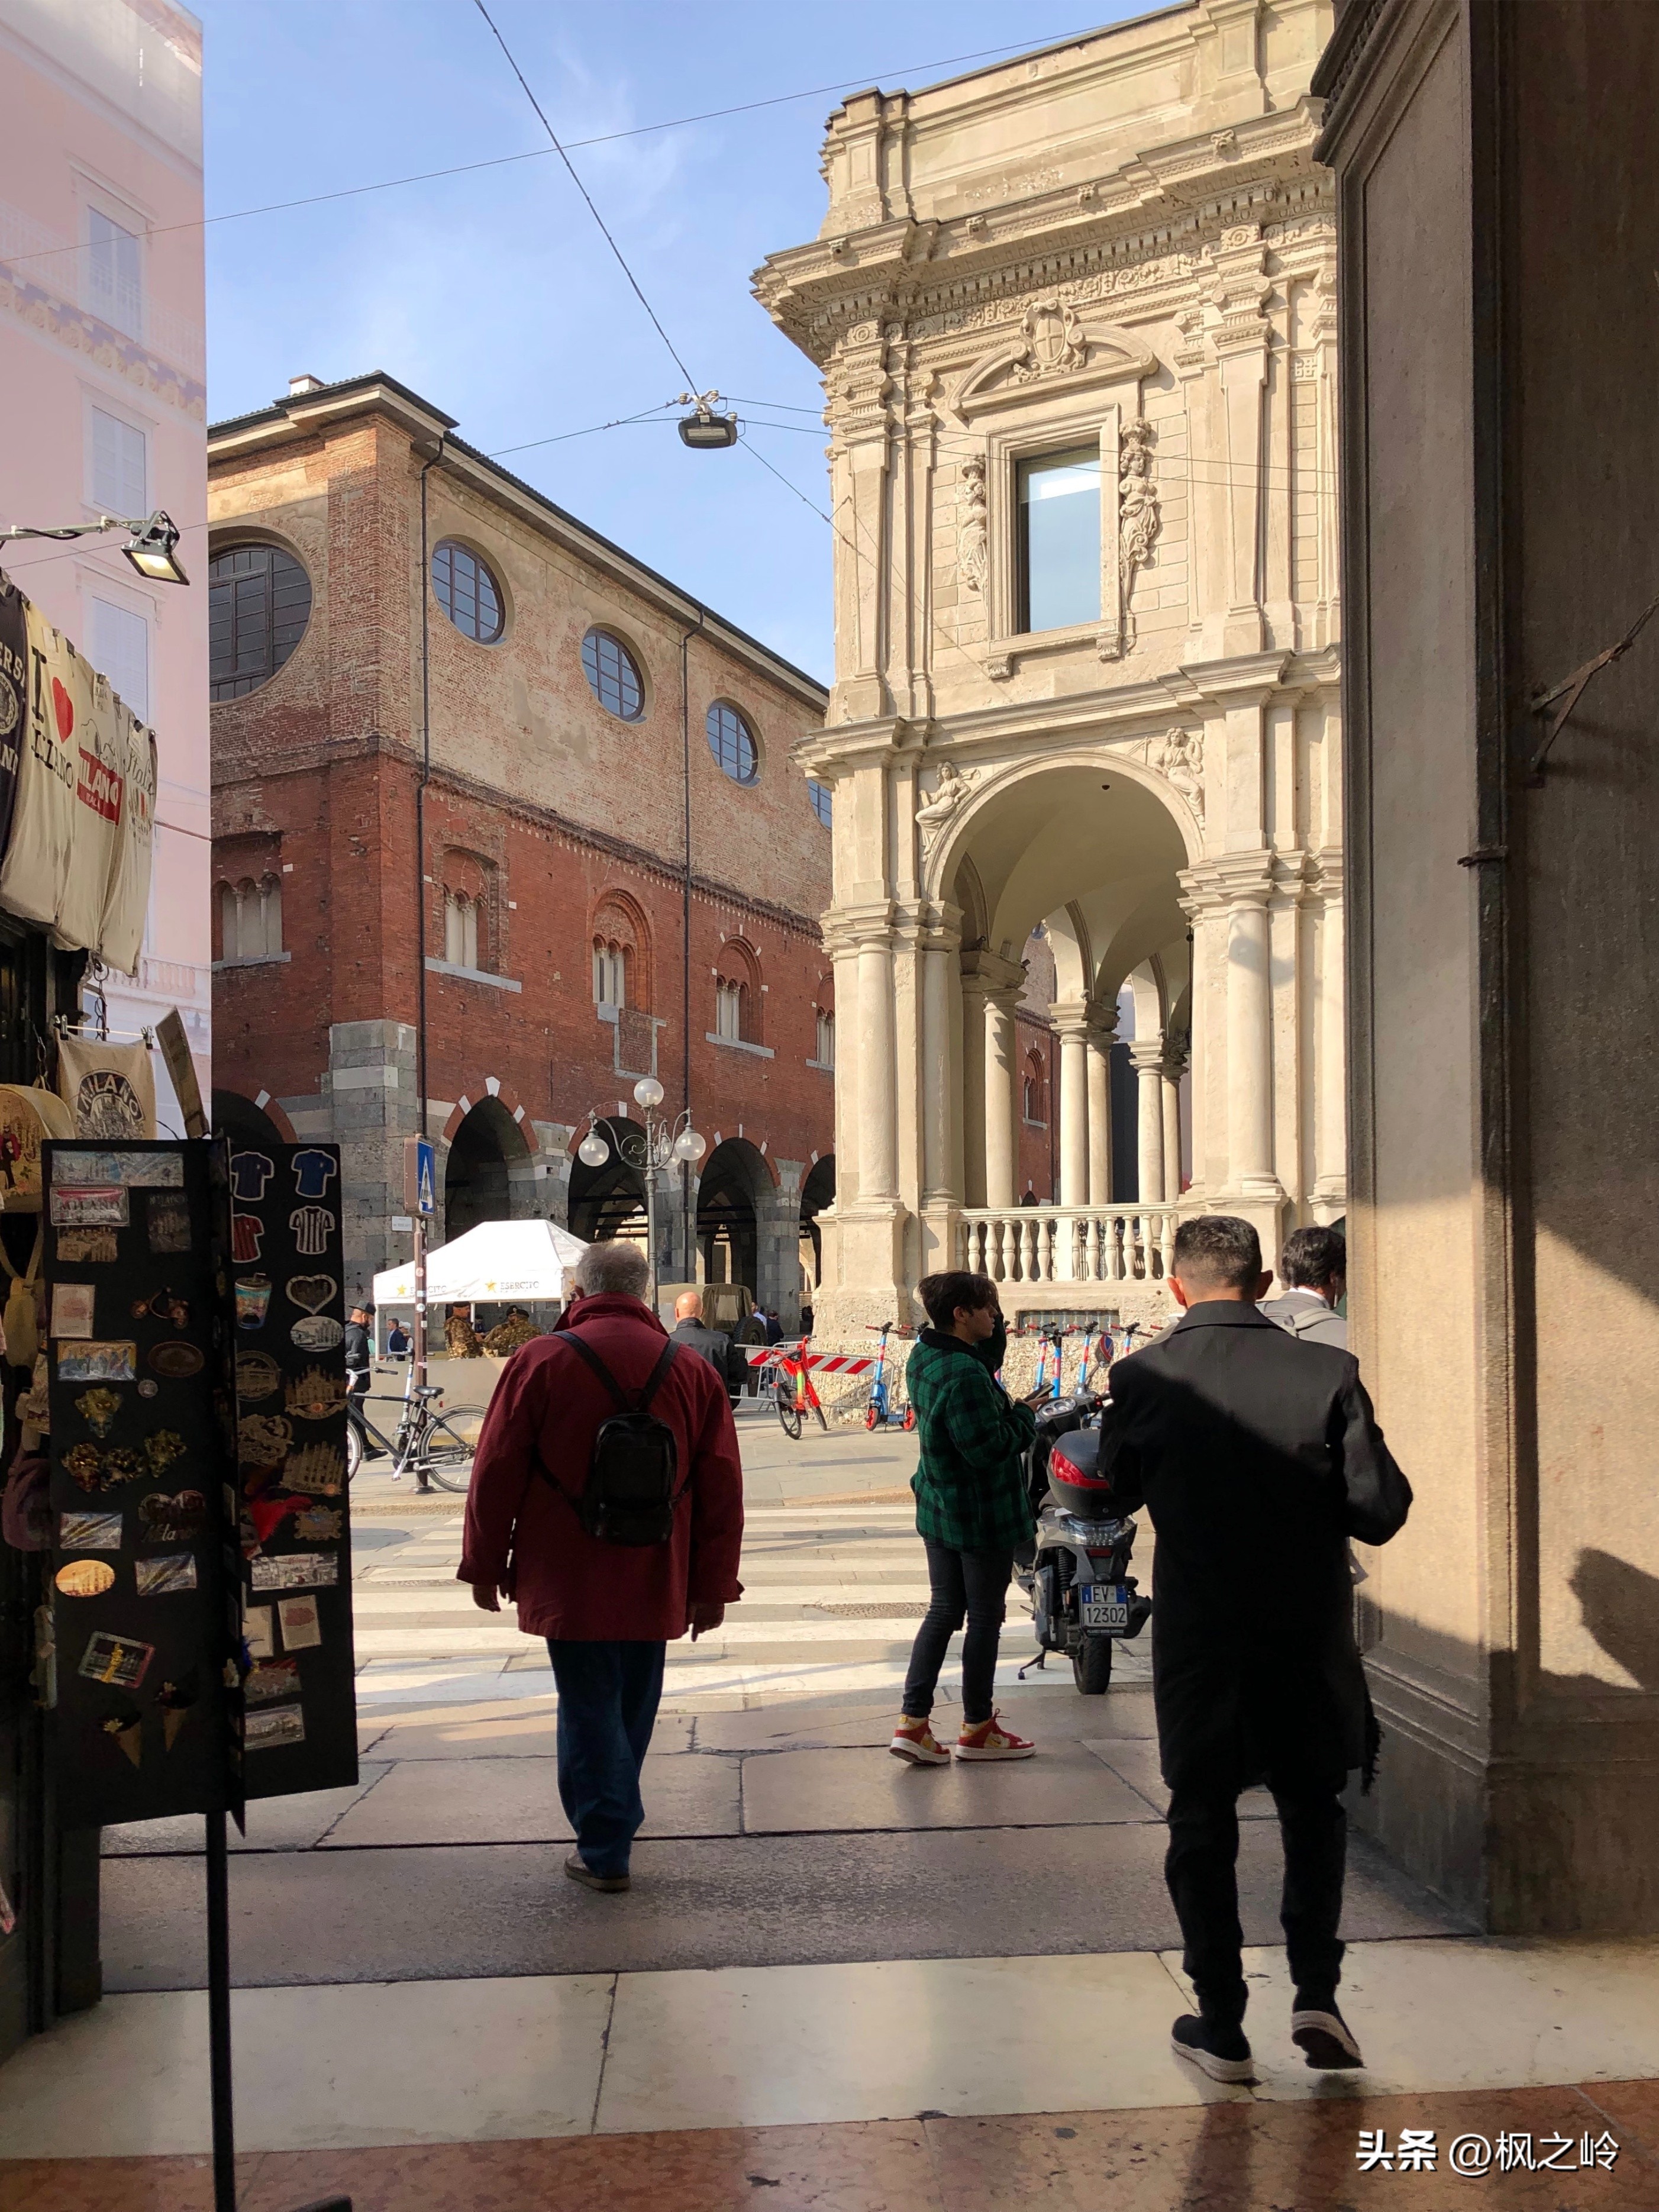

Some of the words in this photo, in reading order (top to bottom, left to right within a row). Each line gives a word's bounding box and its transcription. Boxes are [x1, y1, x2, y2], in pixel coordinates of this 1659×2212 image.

[80, 1075, 138, 1117] MILANO
[410, 1285, 447, 1294] ECITO
[500, 1281, 540, 1290] ESERCITO
[1093, 1587, 1108, 1602] EV
[1087, 1607, 1126, 1623] 12302
